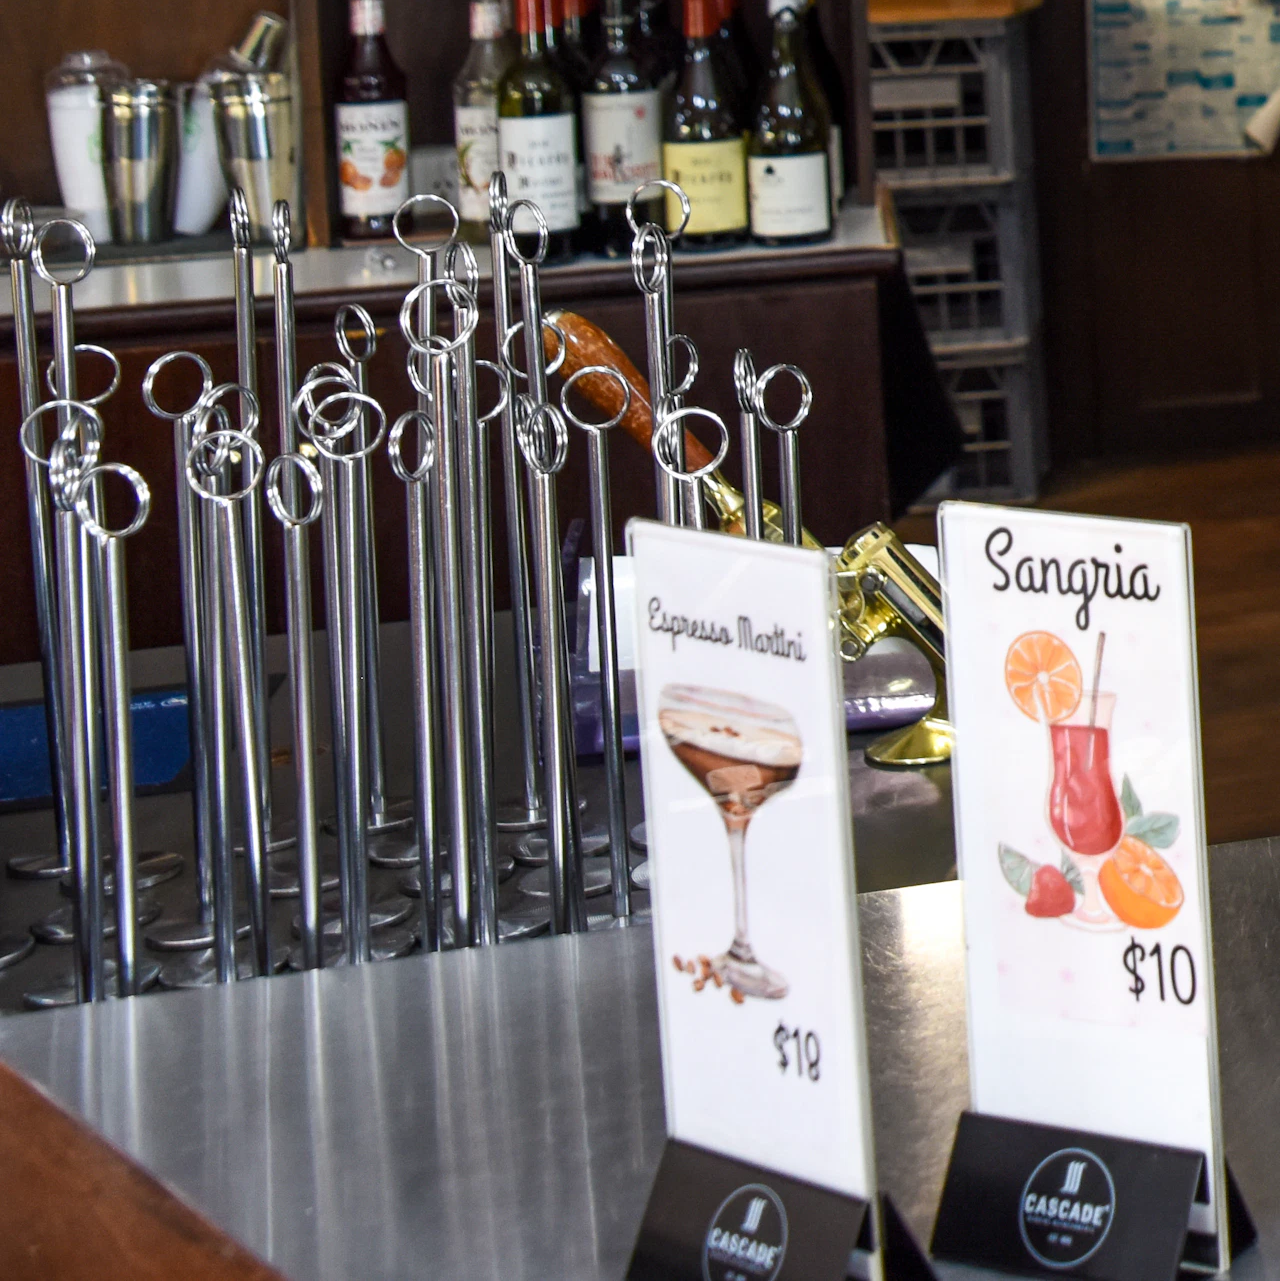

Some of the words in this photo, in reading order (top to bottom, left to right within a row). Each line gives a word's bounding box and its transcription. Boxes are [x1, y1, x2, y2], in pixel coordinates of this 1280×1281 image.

[984, 526, 1160, 631] Sangria
[648, 596, 733, 652] Espresso
[1123, 936, 1197, 1005] $10
[1024, 1192, 1104, 1227] CASCADE
